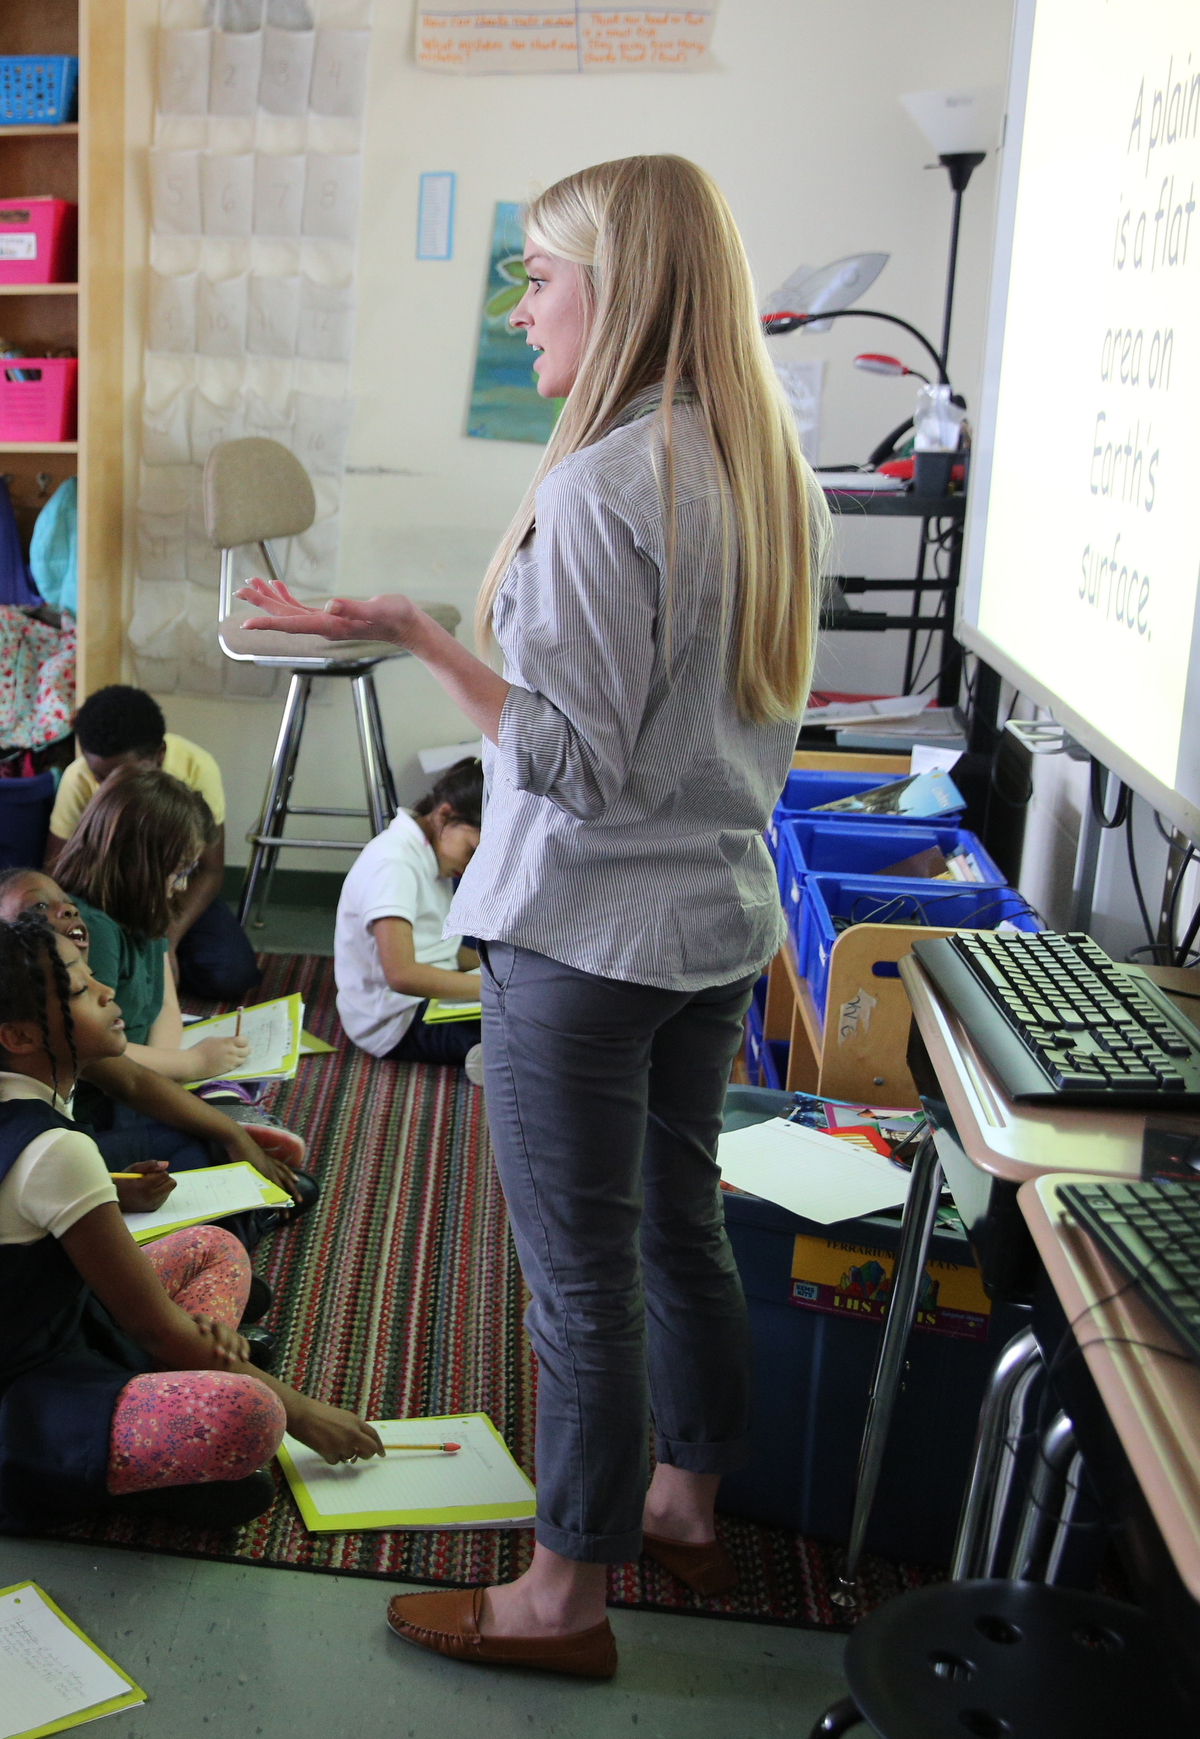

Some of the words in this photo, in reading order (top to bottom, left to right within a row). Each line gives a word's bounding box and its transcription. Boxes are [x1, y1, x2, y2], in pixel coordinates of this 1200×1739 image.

[1127, 73, 1145, 155] A
[1145, 50, 1200, 180] plain
[319, 178, 338, 210] 8
[1112, 191, 1131, 272] is
[1134, 209, 1147, 271] a
[1151, 173, 1196, 275] flat
[1100, 327, 1144, 388] area
[1148, 325, 1174, 392] on
[1090, 409, 1160, 513] Earth's
[1078, 531, 1152, 644] surface.
[833, 1295, 872, 1313] LHS
